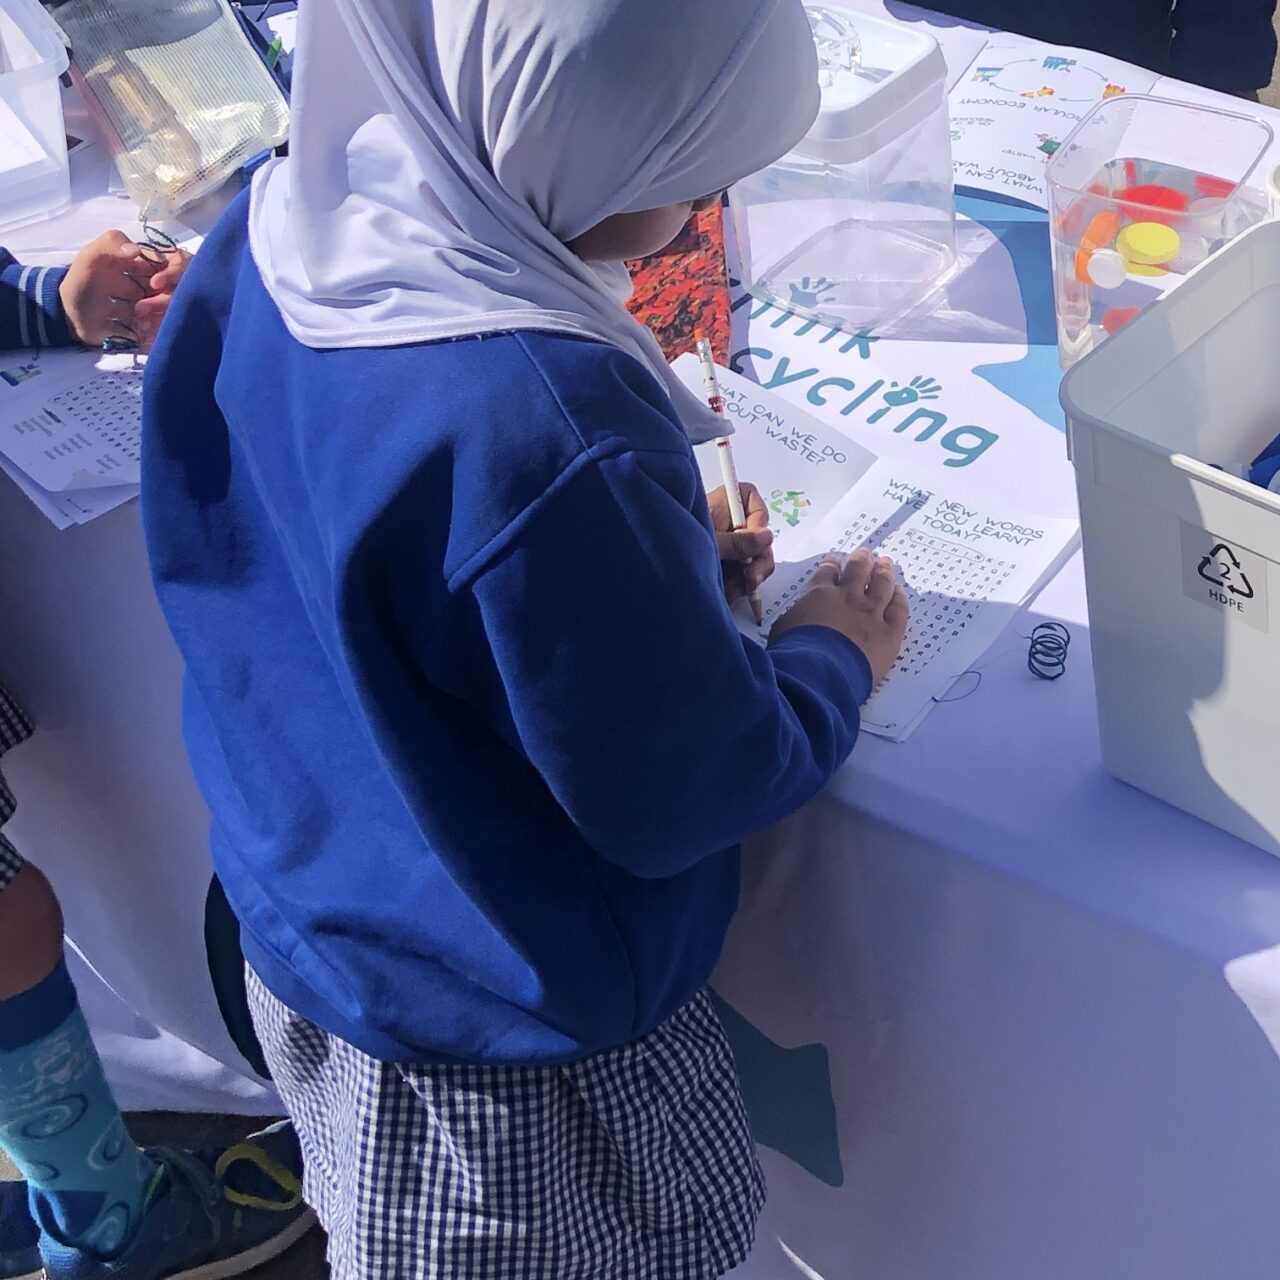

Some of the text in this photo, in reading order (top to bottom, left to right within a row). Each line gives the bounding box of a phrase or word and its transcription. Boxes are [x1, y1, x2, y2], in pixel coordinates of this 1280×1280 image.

[958, 97, 1027, 110] ECONOMY
[1033, 105, 1083, 122] RCULAR
[951, 159, 1036, 183] ABOUT WAS
[965, 168, 1043, 195] WHAT CAN
[719, 396, 827, 466] BOUT WASTE?
[752, 403, 785, 428] CAN
[791, 426, 818, 447] WE
[820, 445, 848, 465] DO
[881, 488, 1035, 548] HAVE YOU LEARNT
[888, 478, 1045, 540] WHAT NEW WORDS
[922, 514, 983, 543] TODAY?
[1219, 562, 1232, 581] 2
[1208, 588, 1245, 613] HDPE
